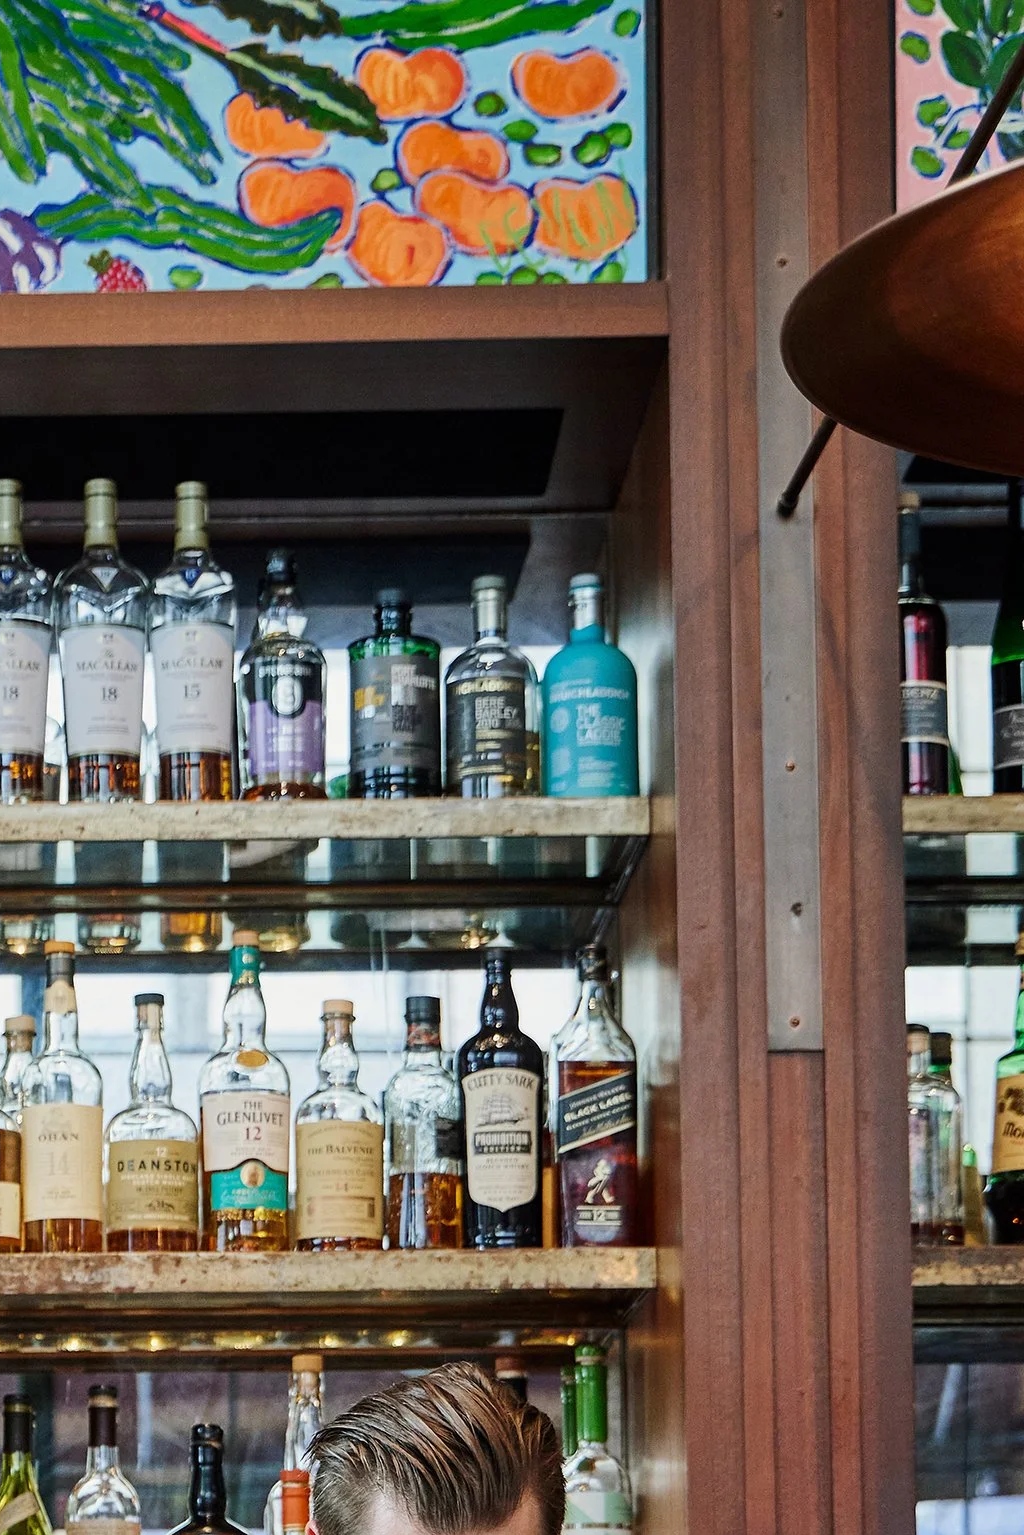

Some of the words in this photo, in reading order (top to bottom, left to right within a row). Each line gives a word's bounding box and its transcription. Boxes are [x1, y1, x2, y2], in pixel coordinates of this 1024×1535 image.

[75, 660, 139, 673] MACALLAN
[160, 658, 225, 671] MACALLAN
[2, 685, 20, 701] 18
[101, 685, 119, 702] 18
[183, 683, 201, 700] 15
[476, 696, 506, 709] BERE
[577, 702, 601, 716] THE
[476, 706, 518, 720] BARLEY
[577, 714, 625, 731] CLASSIC
[577, 727, 622, 743] LADDIE
[467, 1073, 503, 1092] CUTTY
[504, 1073, 535, 1091] SARK
[243, 1100, 263, 1110] THE
[564, 1103, 599, 1123] BLACK
[599, 1092, 633, 1110] LABEL
[217, 1111, 284, 1128] GLENLIVET
[38, 1133, 80, 1143] OBAN
[245, 1127, 262, 1142] 12
[475, 1133, 531, 1147] PROHIBITION
[155, 1146, 168, 1158] 12
[326, 1144, 375, 1155] BALVENIE
[117, 1159, 198, 1174] DEANSTON
[592, 1209, 606, 1222] 12
